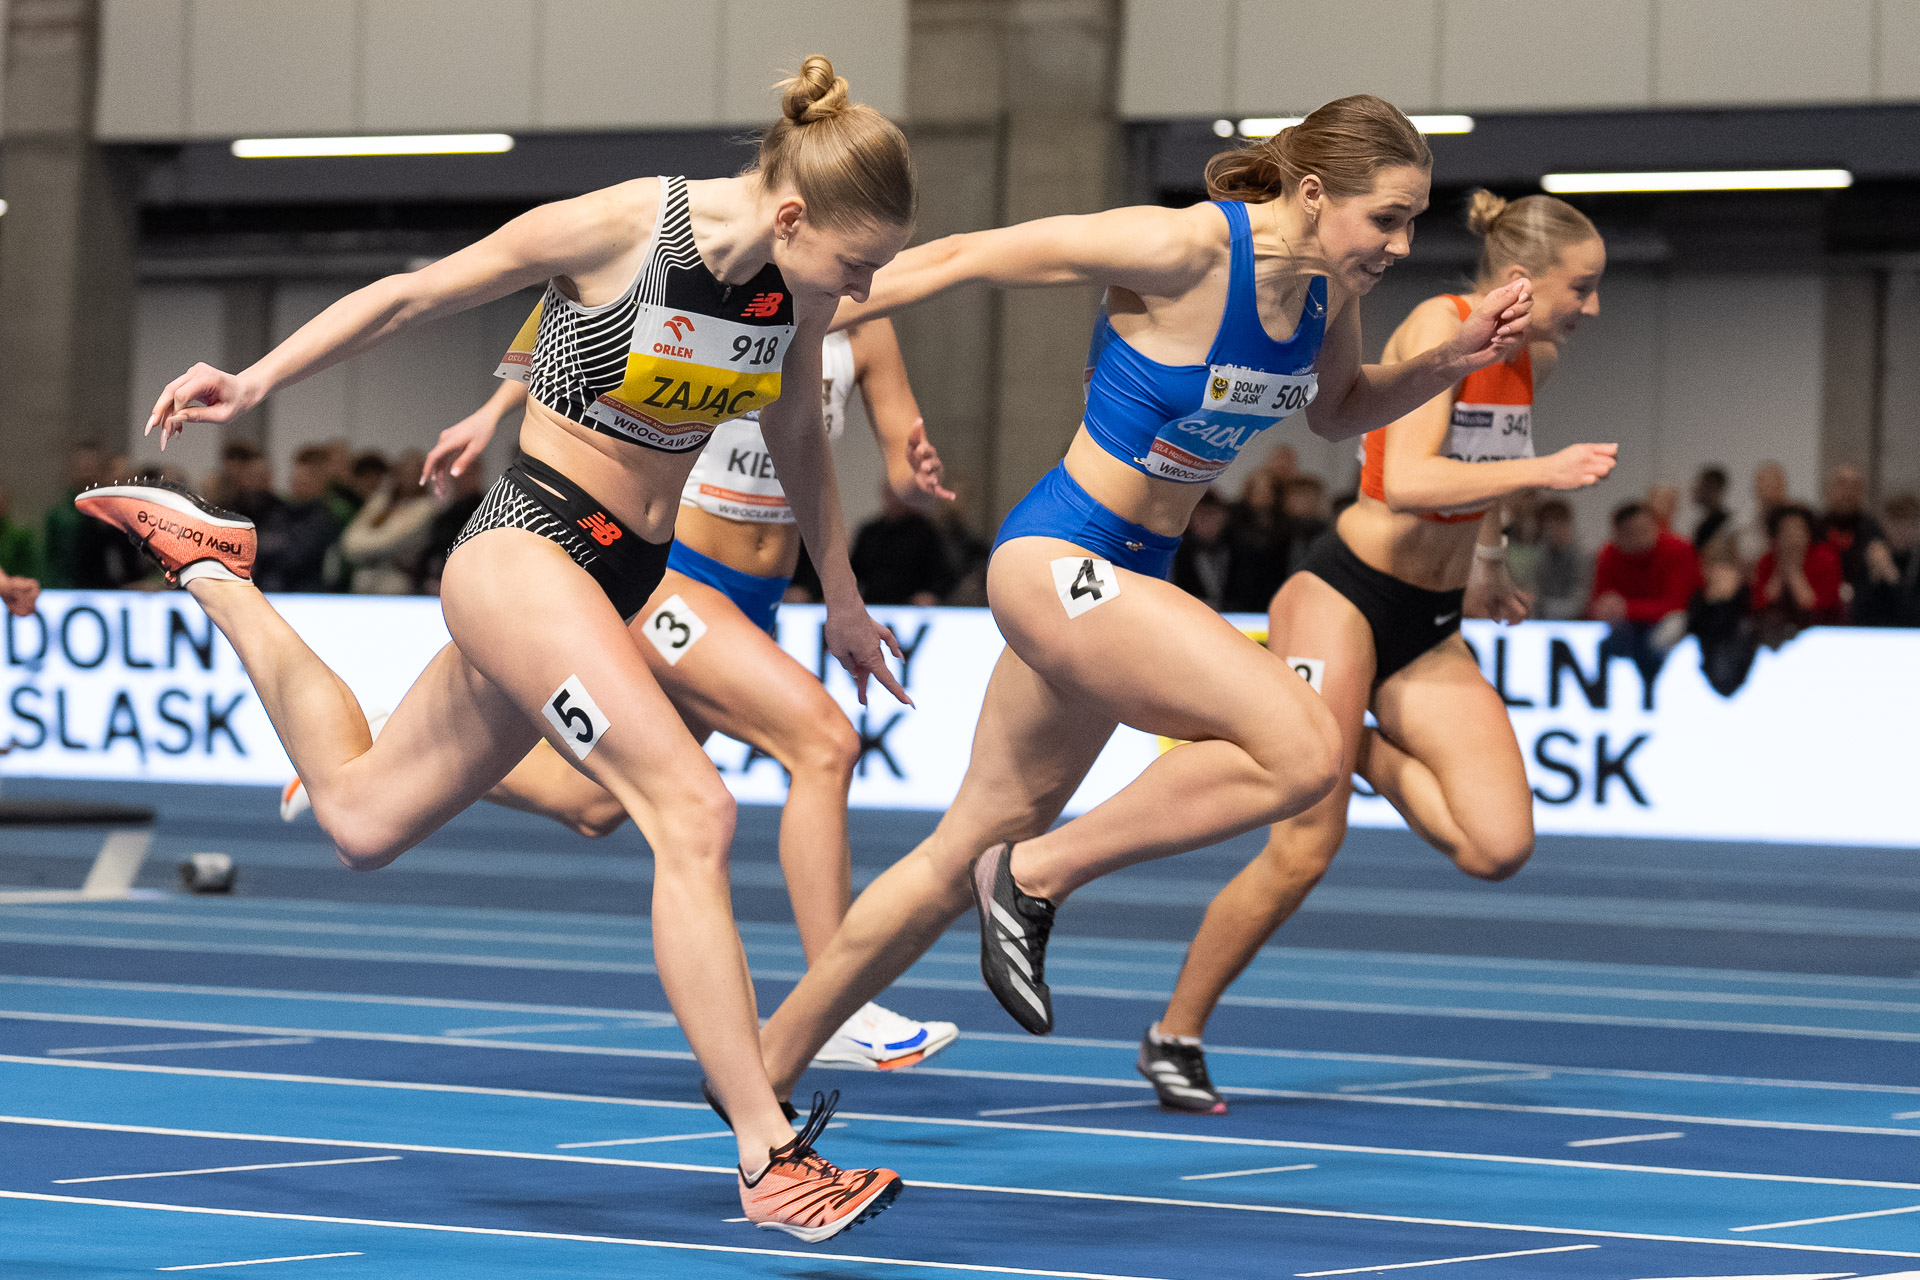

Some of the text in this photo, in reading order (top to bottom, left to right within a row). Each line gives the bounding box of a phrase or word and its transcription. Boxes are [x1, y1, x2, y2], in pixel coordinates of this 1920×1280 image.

[653, 342, 694, 359] ORLEN
[729, 335, 779, 365] 918
[603, 397, 621, 409] PZLA
[642, 375, 756, 418] ZAJĄC
[1233, 380, 1269, 394] DOLNY
[614, 415, 688, 448] WROCŁAW
[727, 448, 779, 479] KIE
[137, 510, 242, 556] new balance
[1070, 559, 1105, 601] 4
[5, 606, 216, 671] DOLN
[655, 611, 691, 649] 3
[551, 688, 594, 744] 5
